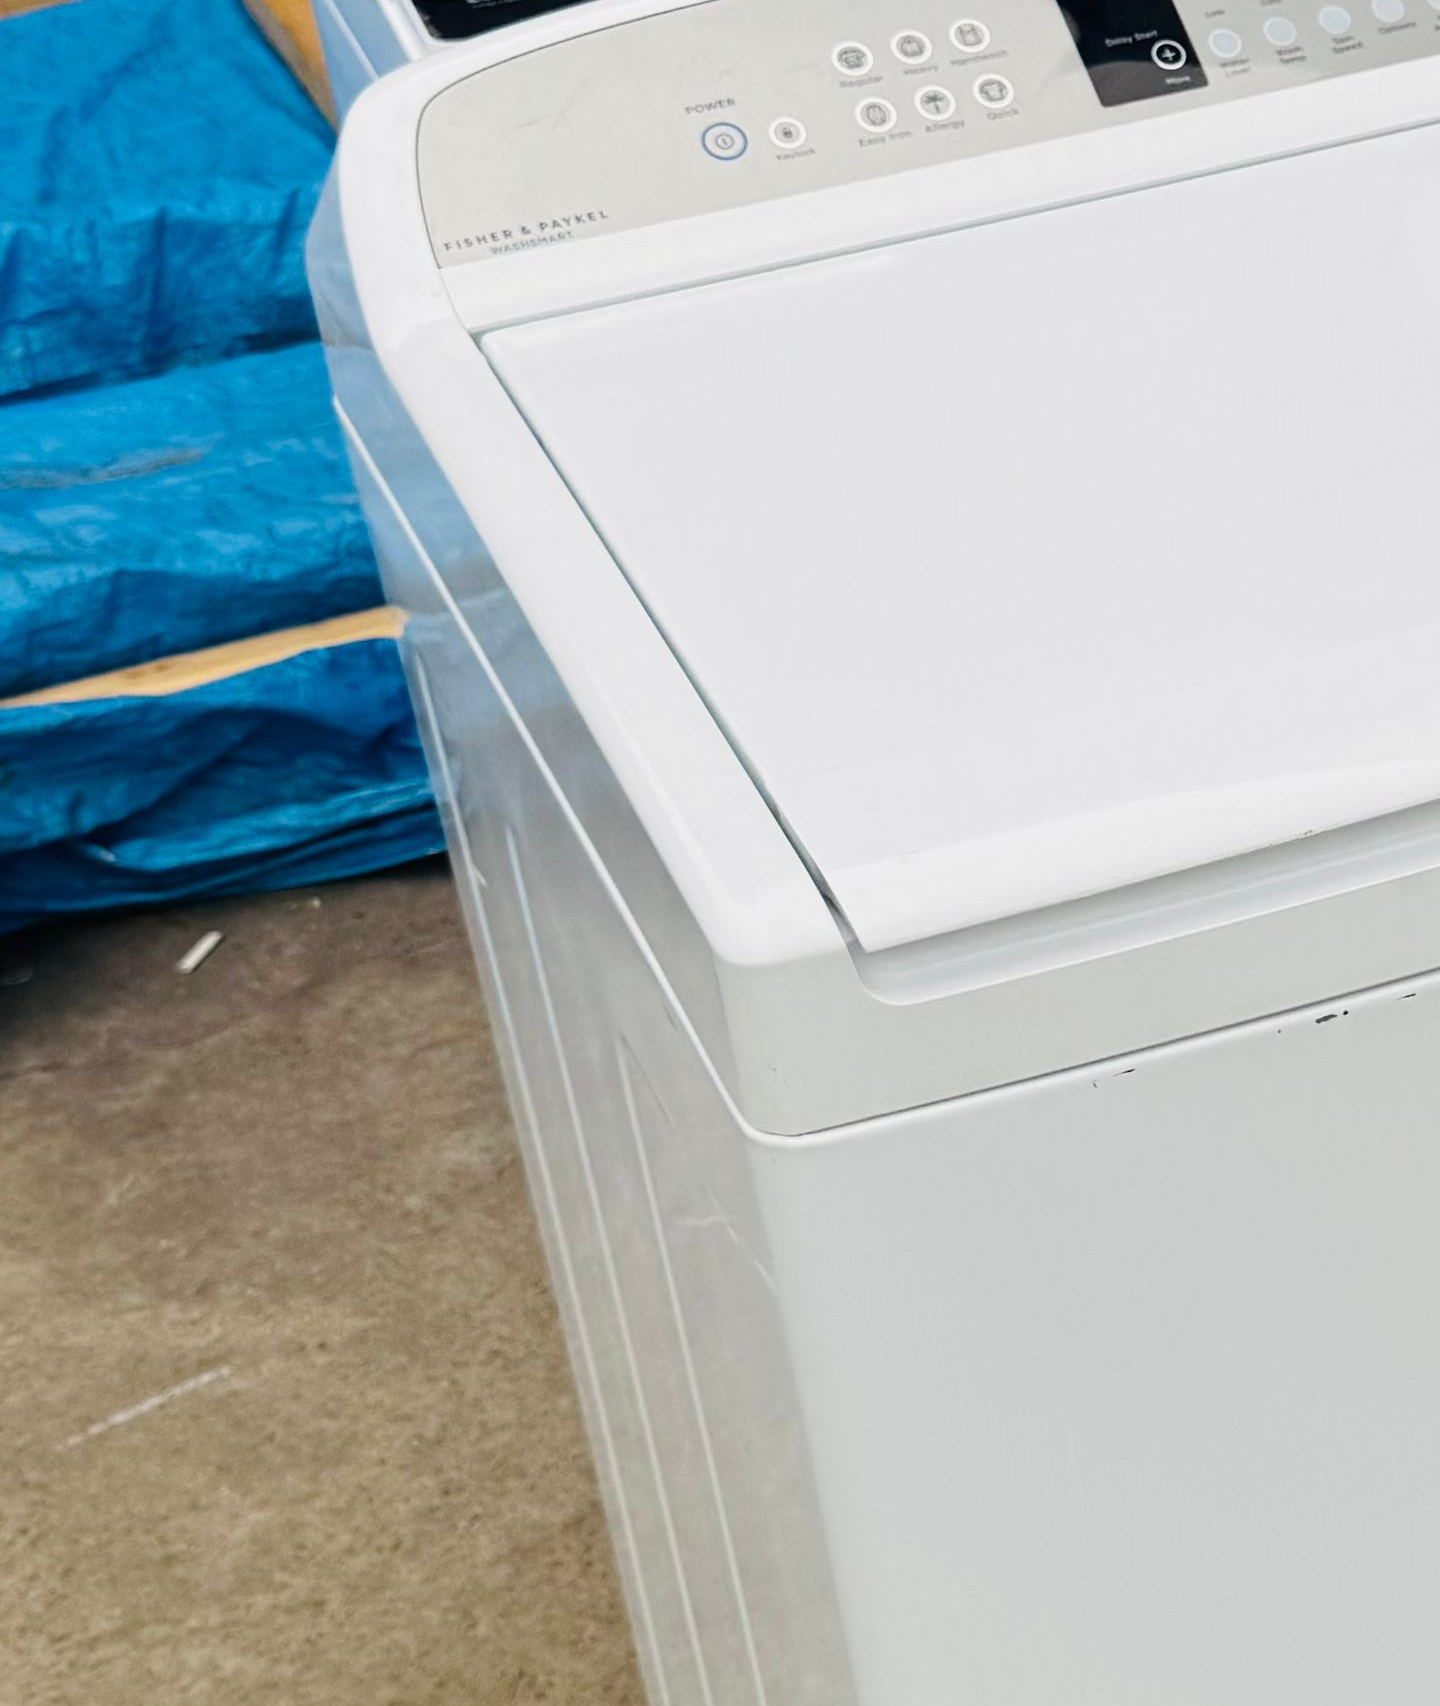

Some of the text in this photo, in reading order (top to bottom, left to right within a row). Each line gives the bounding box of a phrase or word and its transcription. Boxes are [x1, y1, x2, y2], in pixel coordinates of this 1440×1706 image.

[685, 98, 736, 115] POWER
[444, 209, 609, 252] FISHER & PAYKEL
